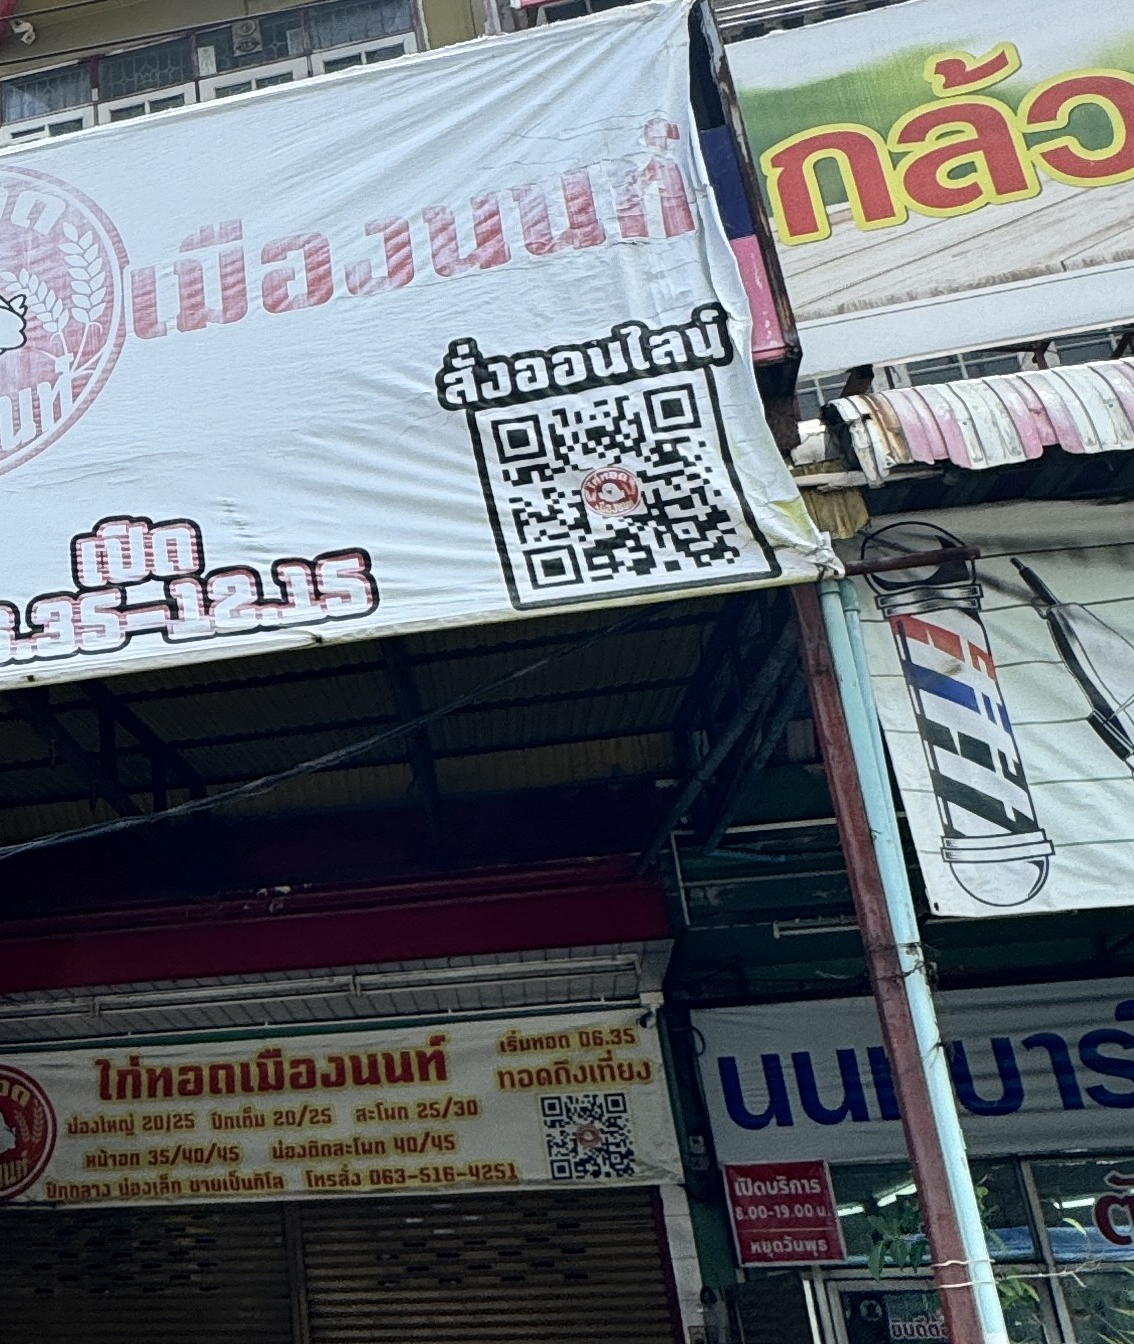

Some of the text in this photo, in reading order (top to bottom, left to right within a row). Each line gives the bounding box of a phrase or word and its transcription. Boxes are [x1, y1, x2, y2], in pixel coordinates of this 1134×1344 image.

[438, 306, 732, 410] สั่งออนไลน์
[499, 1027, 636, 1054] เริ่มทอด 06.35
[95, 1034, 447, 1100] ไก่ทอดเมืองนนท์
[497, 1049, 652, 1090] ทอดถึงเที่ยง
[68, 1114, 135, 1136] น่องใหญ่
[142, 1112, 196, 1133] 20/25
[273, 1105, 332, 1128] 20/25
[417, 1097, 479, 1120] 25/30
[85, 1144, 141, 1169] หน้าอก
[147, 1143, 241, 1167] 35/40/45
[393, 1130, 457, 1155] 40/45
[369, 1161, 519, 1187] 063-516-4251
[733, 1174, 822, 1197] เปิดบริการ
[750, 1234, 828, 1259] หยุดวันพุธ
